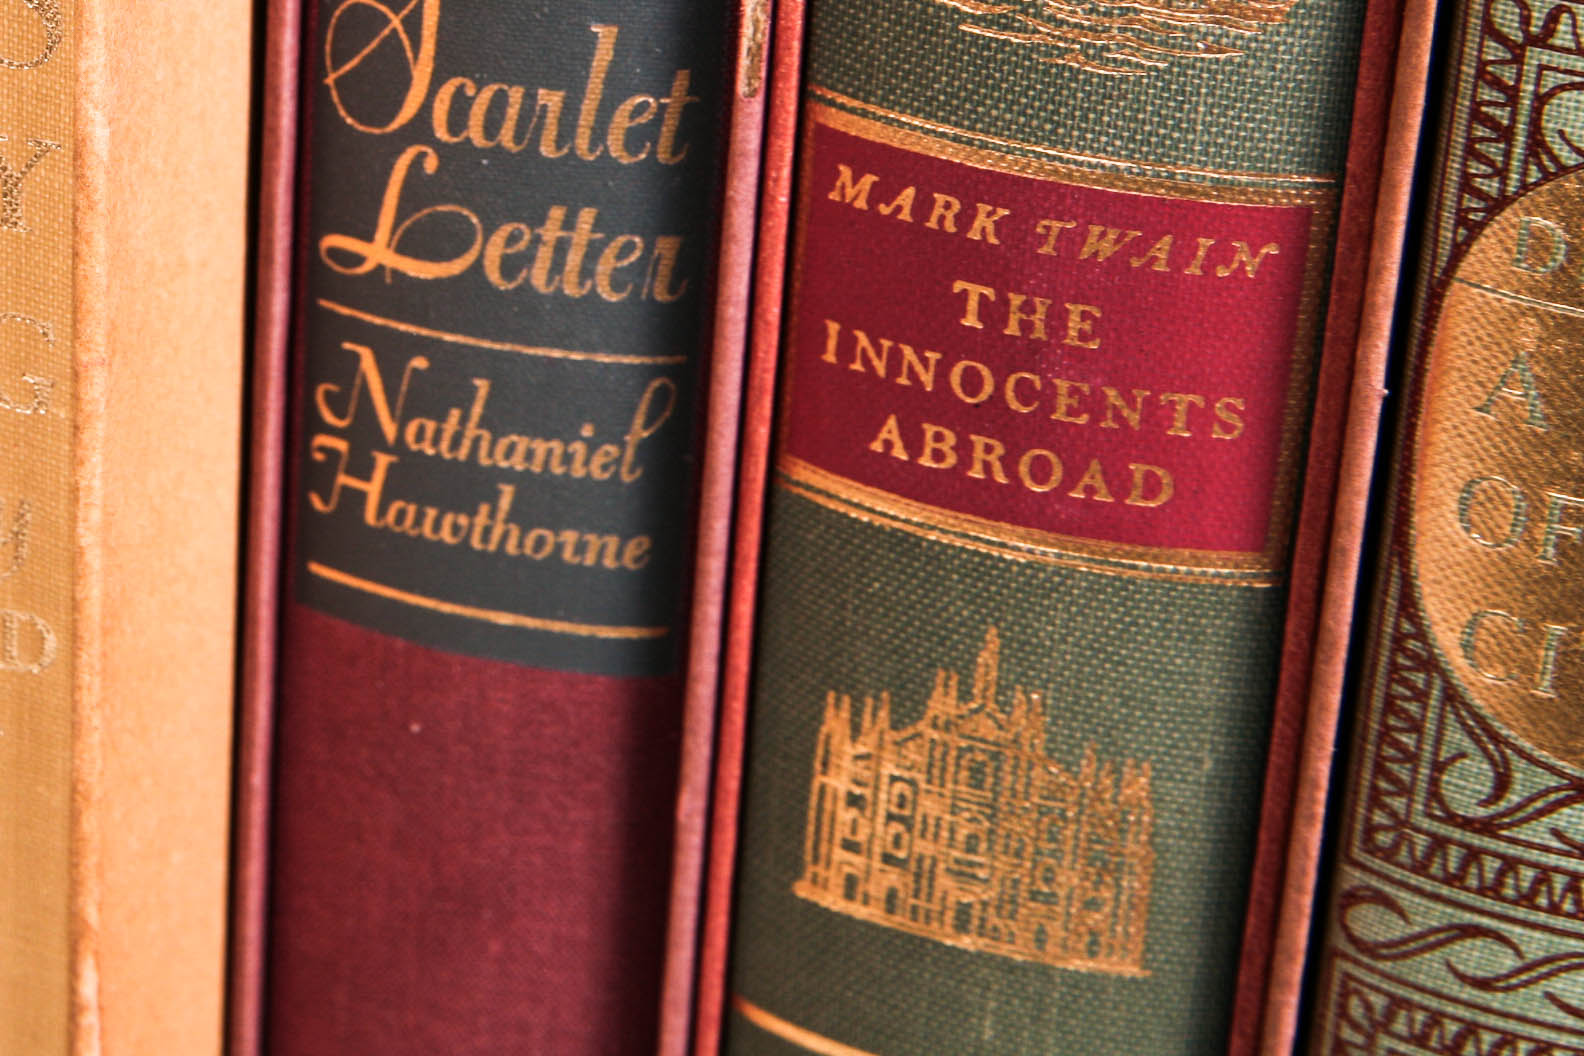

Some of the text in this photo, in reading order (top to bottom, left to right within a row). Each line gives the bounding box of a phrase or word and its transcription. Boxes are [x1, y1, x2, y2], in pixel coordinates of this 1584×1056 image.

[318, 145, 689, 301] Letter
[828, 163, 1280, 280] MARK TWAIN
[953, 279, 1103, 349] THE
[315, 341, 677, 483] Nathaniel
[820, 319, 1246, 440] INNOCENTS
[309, 433, 651, 571] Hawthorne
[869, 413, 1175, 508] ABROAD
